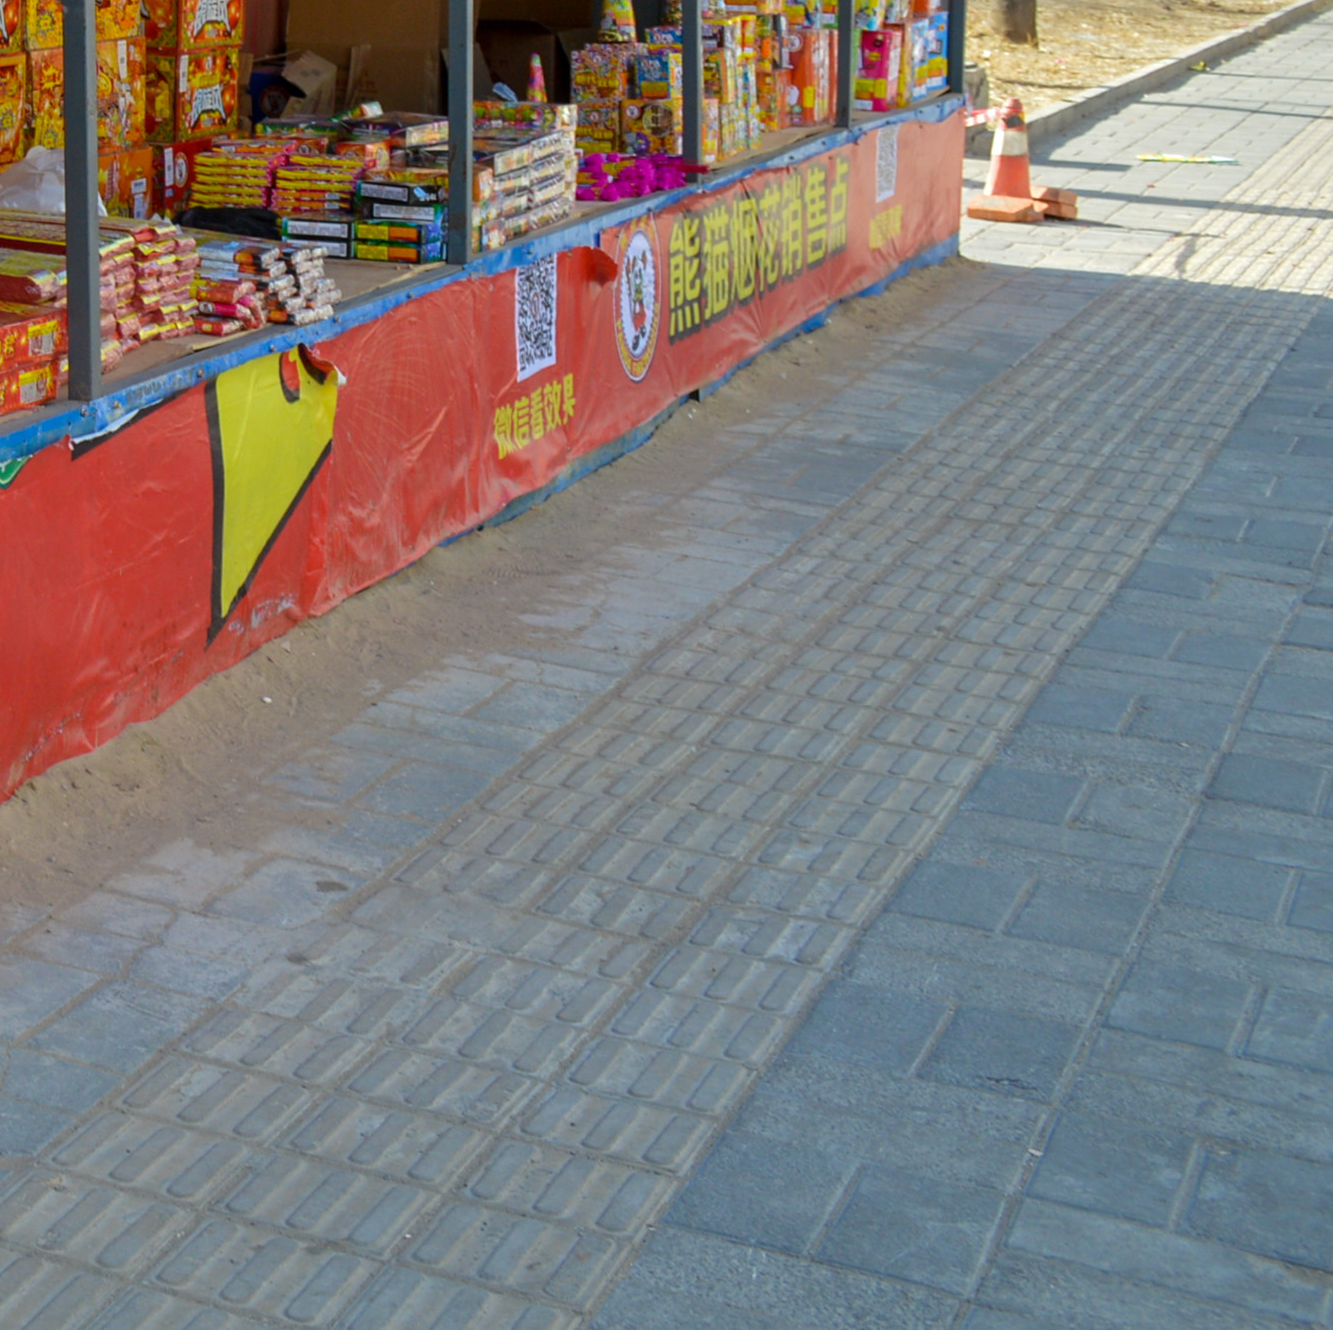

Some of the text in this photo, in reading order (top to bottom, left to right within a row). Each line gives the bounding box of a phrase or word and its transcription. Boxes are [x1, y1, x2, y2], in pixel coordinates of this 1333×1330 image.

[494, 373, 576, 460] 微信看效果
